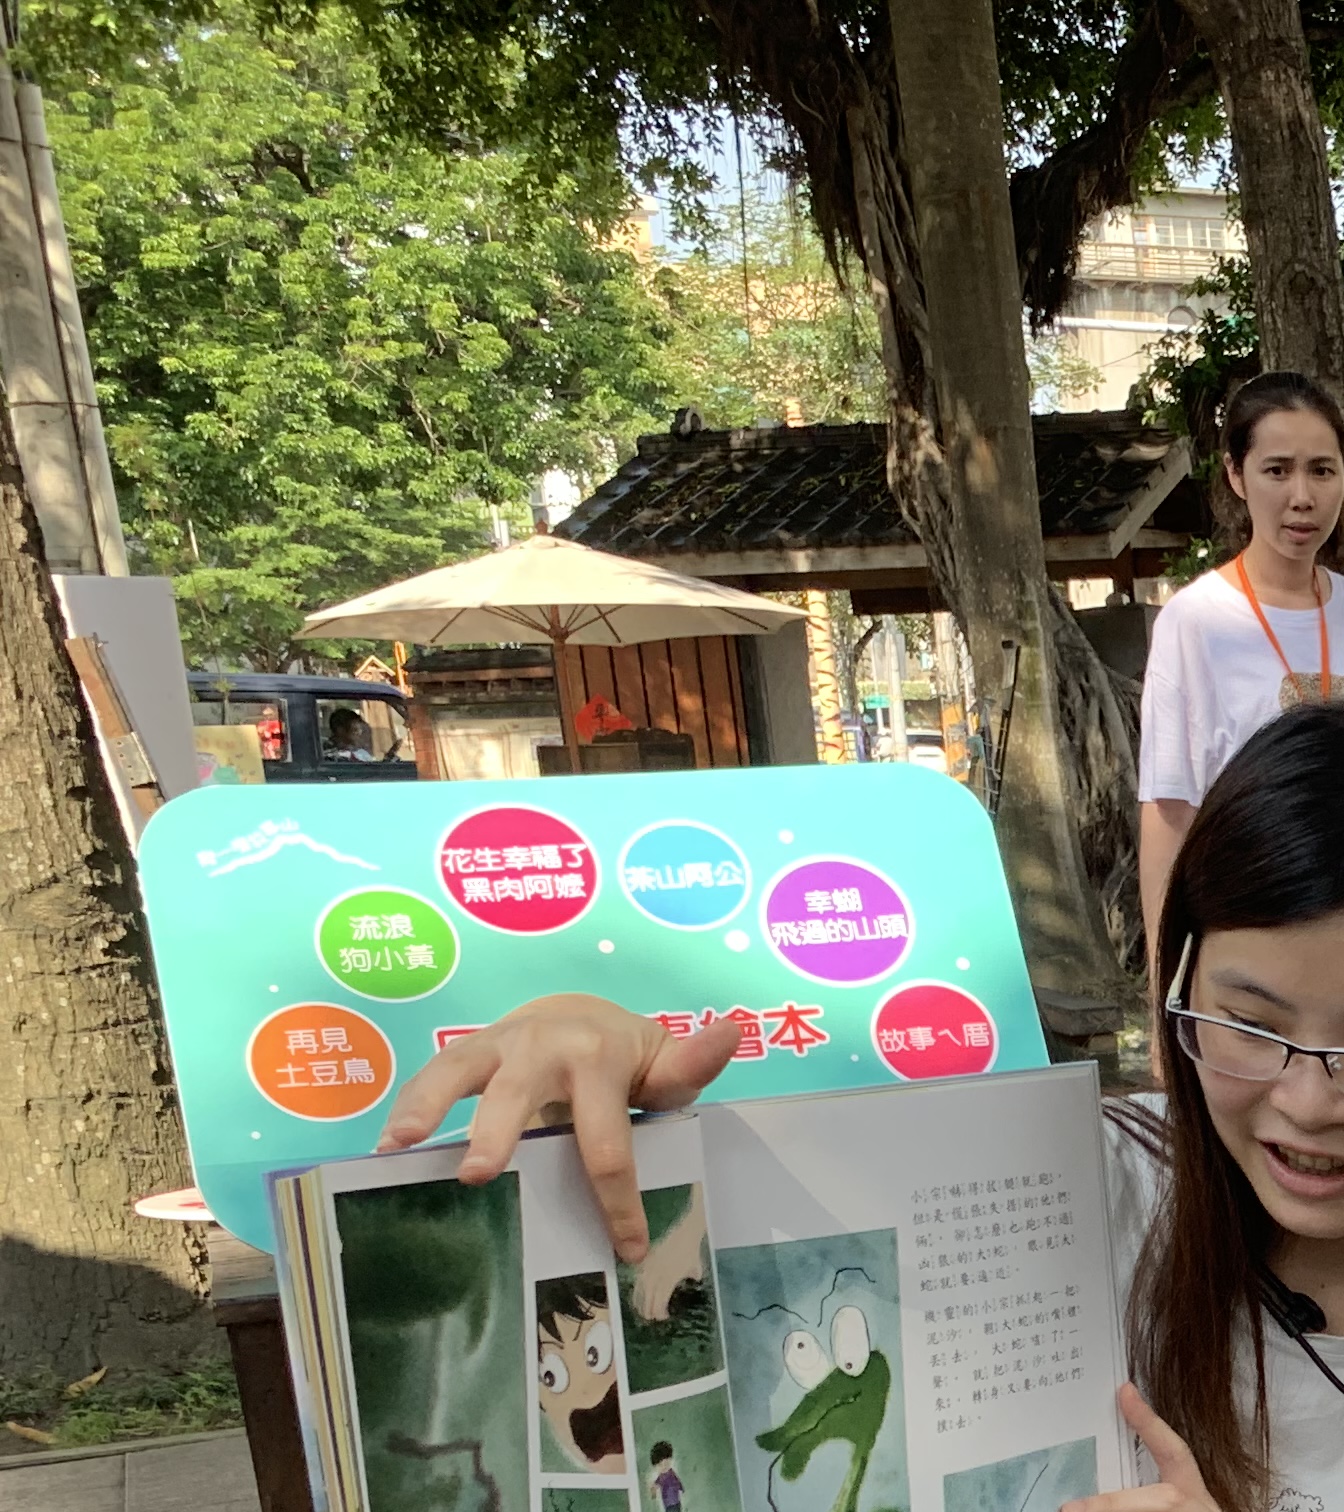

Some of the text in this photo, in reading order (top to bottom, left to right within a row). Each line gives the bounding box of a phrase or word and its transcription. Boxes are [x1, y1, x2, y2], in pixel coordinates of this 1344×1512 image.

[442, 843, 588, 874] 花生幸福了
[349, 914, 416, 941] 流浪
[339, 944, 438, 973] 狗小黃
[284, 1027, 352, 1056] 再見
[276, 1058, 375, 1088] 土豆鳥
